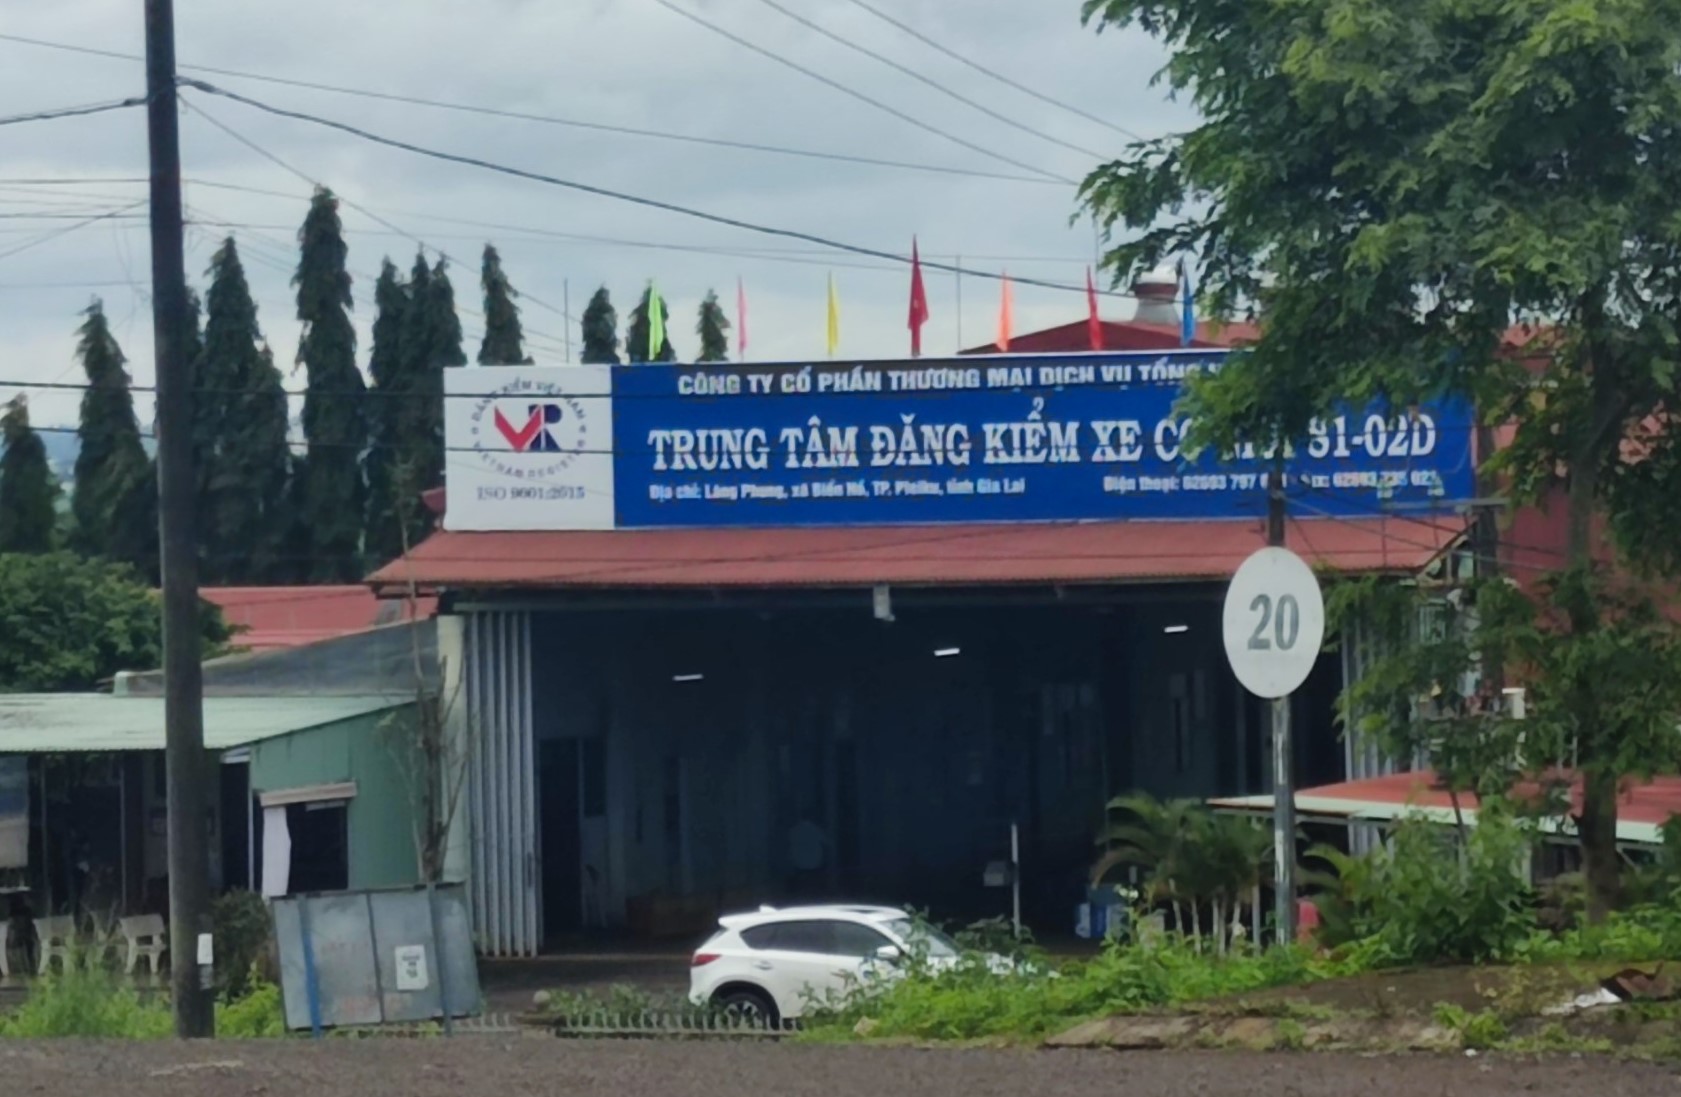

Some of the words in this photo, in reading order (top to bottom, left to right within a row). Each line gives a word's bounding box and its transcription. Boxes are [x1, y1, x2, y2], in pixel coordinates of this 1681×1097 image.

[678, 372, 740, 395] CÔNG
[747, 373, 773, 394] TY
[889, 368, 981, 391] THƯƠNG
[987, 366, 1032, 392] MẠI
[1039, 366, 1095, 391] DỊCH
[1101, 365, 1132, 391] VỤ
[648, 427, 771, 472] TRUNG
[780, 415, 860, 470] TÂM
[870, 413, 972, 468] ĐĂNG
[983, 397, 1081, 465] KIỂM
[1091, 419, 1143, 463] XE
[477, 487, 507, 501] ISO
[872, 480, 892, 496] TP.
[977, 478, 1001, 494] Gia
[1003, 477, 1026, 494] Lai
[1247, 593, 1300, 651] 20
